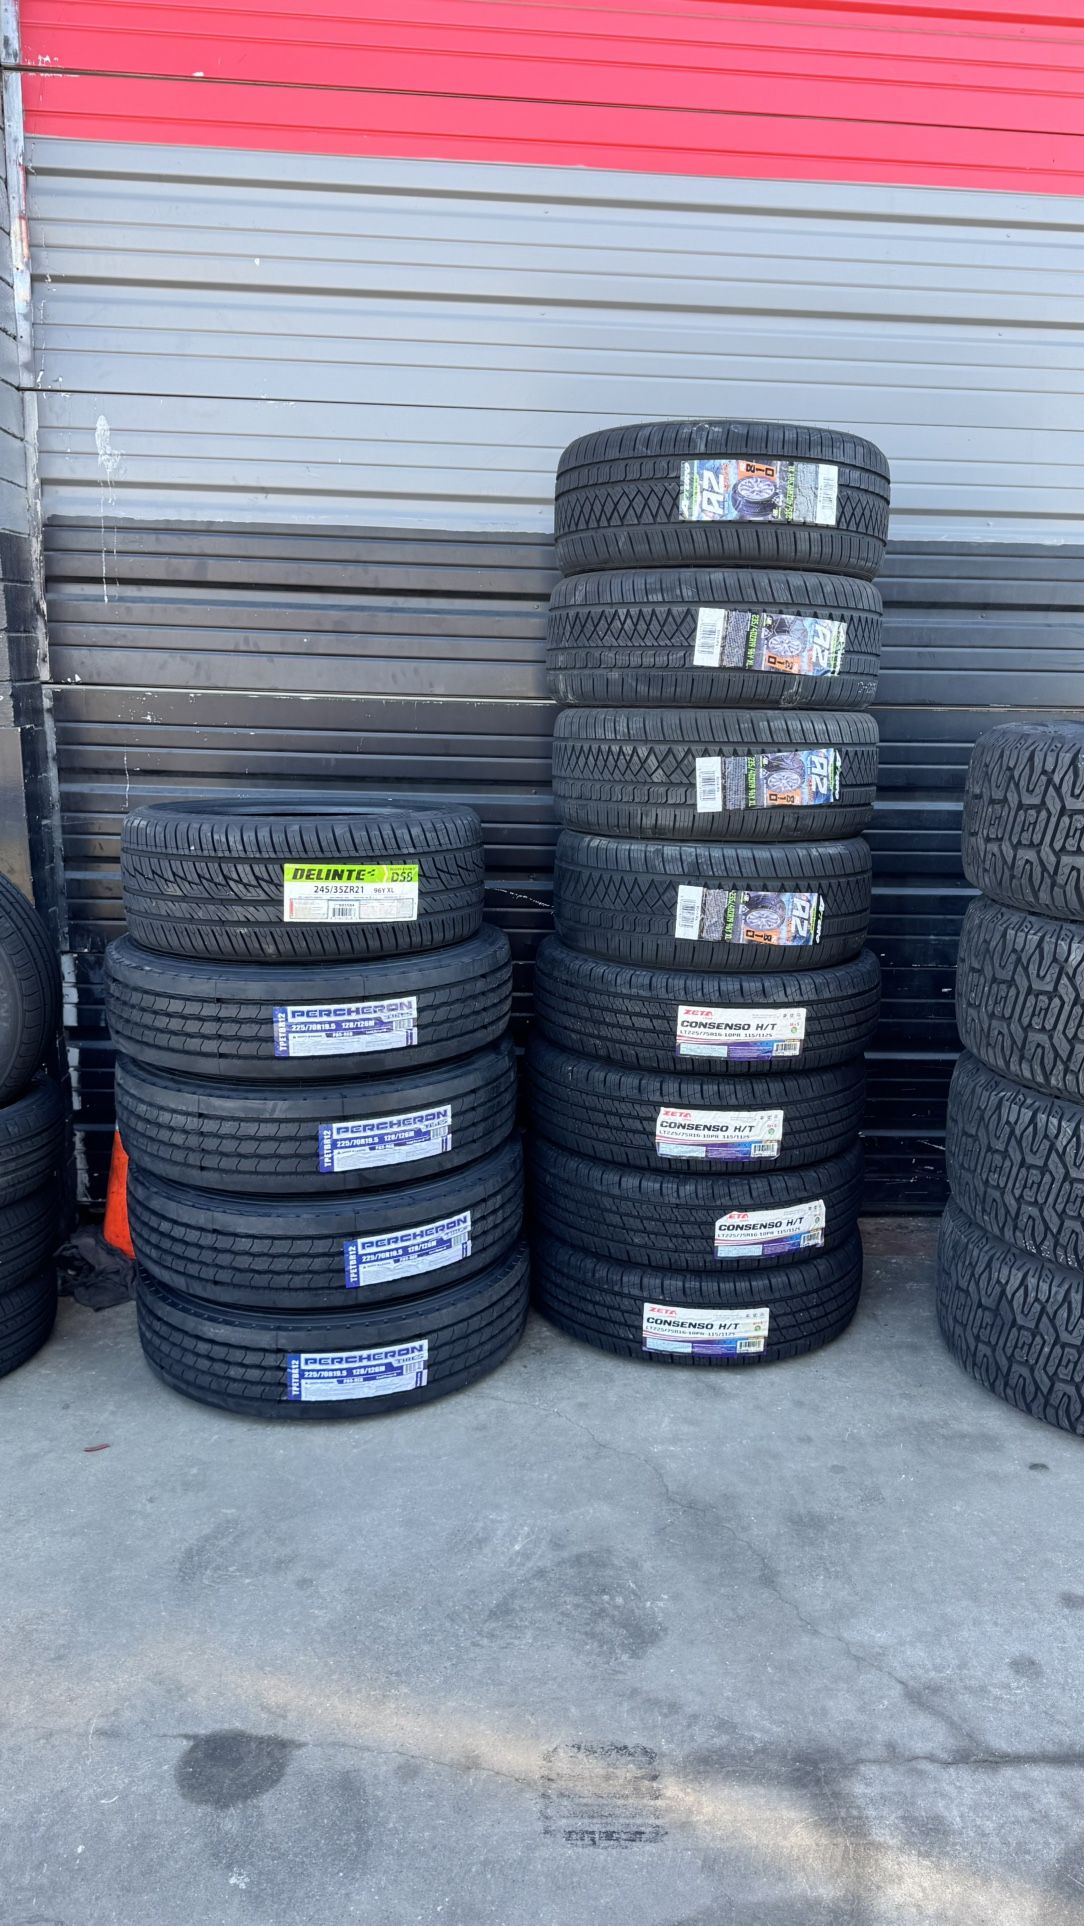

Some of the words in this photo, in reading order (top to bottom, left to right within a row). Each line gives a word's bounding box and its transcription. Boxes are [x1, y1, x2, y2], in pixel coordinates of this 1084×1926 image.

[746, 463, 775, 477] 810
[292, 868, 366, 880] DELINTE
[314, 886, 364, 894] 245/35ZR21
[745, 929, 772, 942] 810
[291, 1001, 413, 1018] PERCHERON
[683, 1009, 713, 1017] ZETA
[291, 1022, 336, 1031] 225/70R19.5
[680, 1020, 751, 1030] CONSENSO
[755, 1023, 777, 1031] H/T
[662, 1110, 692, 1118] ZETA
[336, 1109, 448, 1135] PERCHERON
[660, 1120, 729, 1132] CONSENSO
[336, 1137, 379, 1147] 225/70R19.5
[718, 1221, 782, 1231] CONSENSO
[786, 1217, 804, 1227] H/T
[361, 1215, 468, 1250] PERCHERON
[362, 1249, 403, 1262] 225/70R19.5
[648, 1306, 677, 1315] ZETA
[646, 1317, 714, 1330] CONSENSO
[718, 1322, 740, 1330] H/T
[304, 1344, 424, 1366] PERCHERON
[304, 1369, 347, 1378] 225/70R19.5
